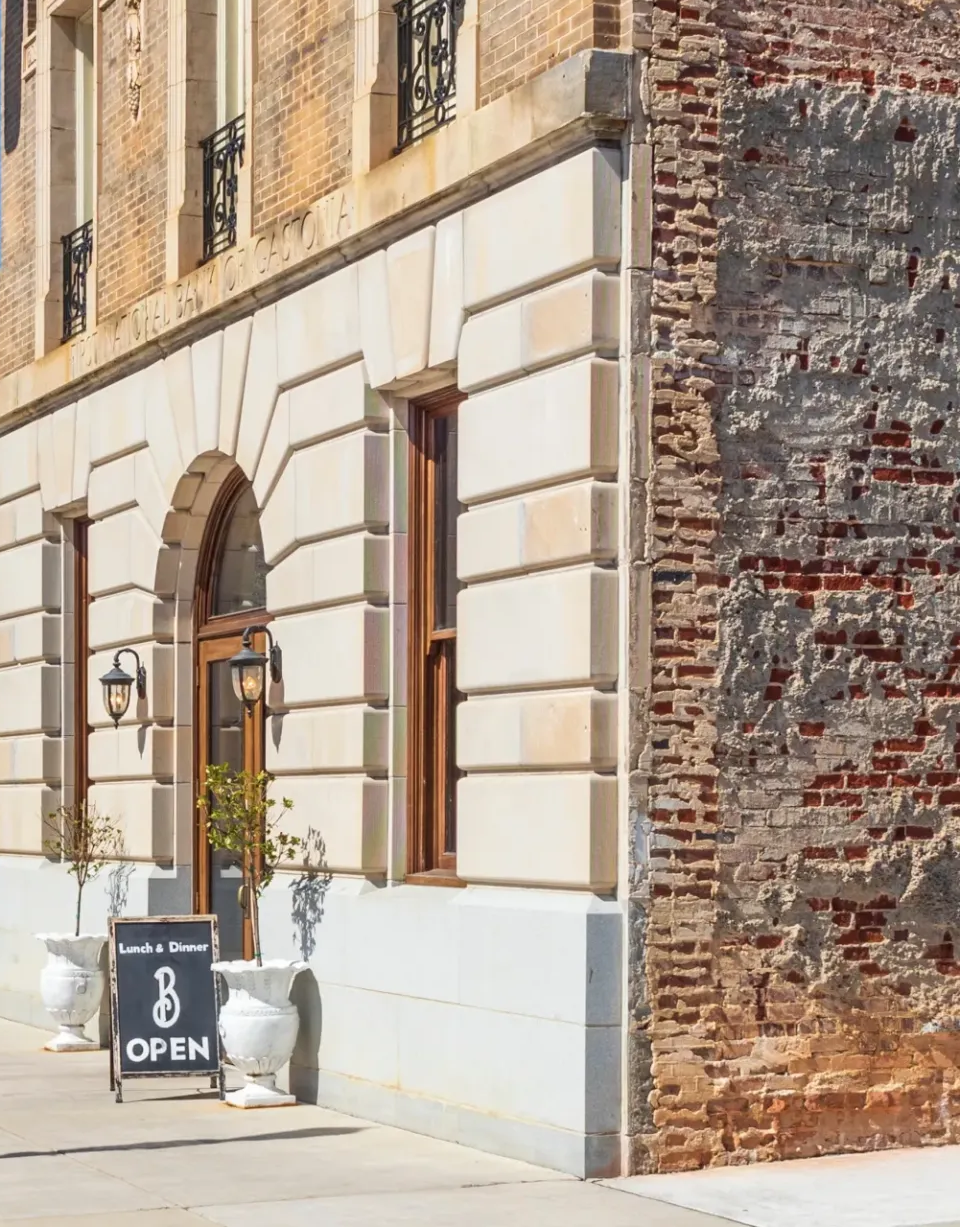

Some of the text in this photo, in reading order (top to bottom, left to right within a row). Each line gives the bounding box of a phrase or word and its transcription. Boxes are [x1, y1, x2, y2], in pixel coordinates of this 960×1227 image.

[119, 941, 209, 954] Lunch & Dinner
[126, 1036, 210, 1062] OPEN
